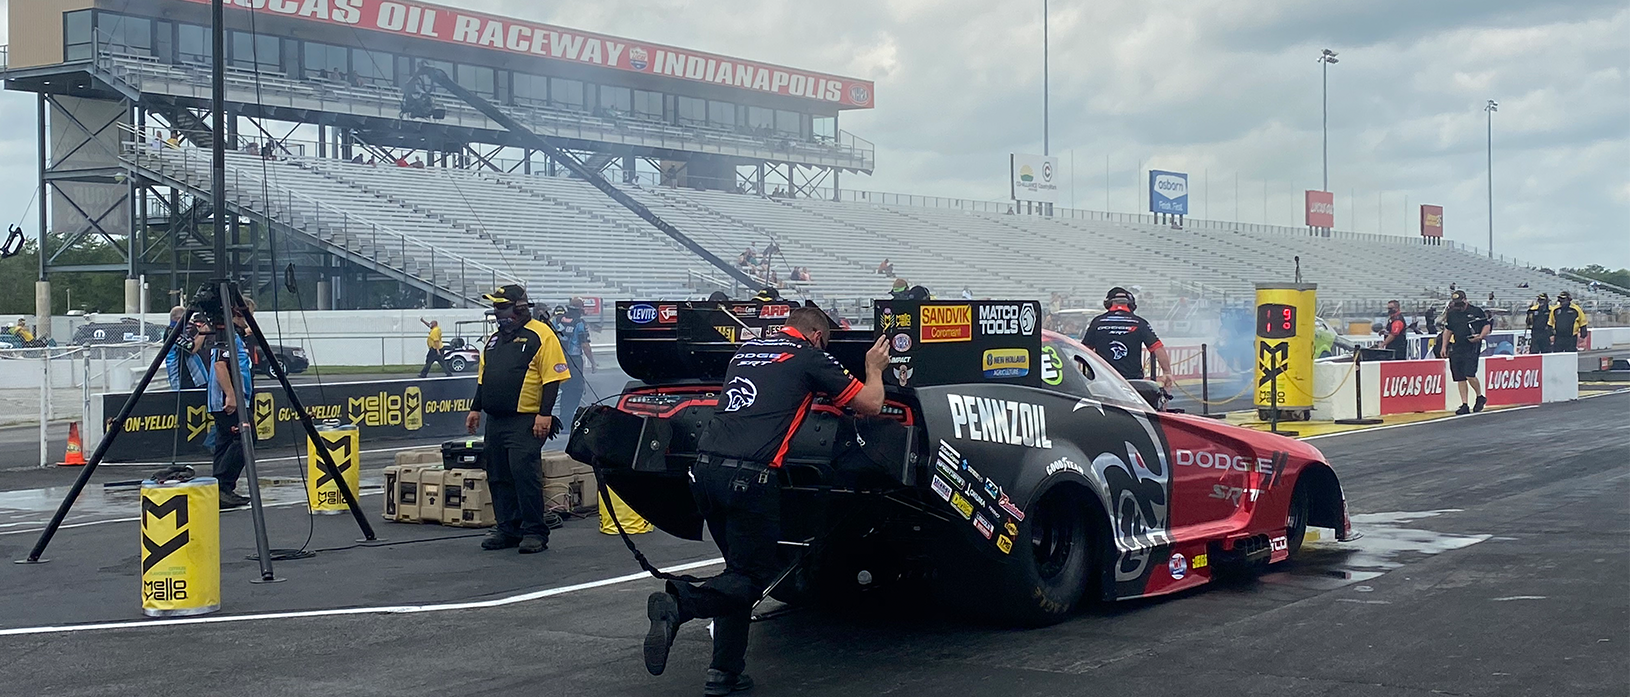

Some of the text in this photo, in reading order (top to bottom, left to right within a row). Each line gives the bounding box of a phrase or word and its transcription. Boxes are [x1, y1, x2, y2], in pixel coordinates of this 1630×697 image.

[223, 0, 362, 25] CAS
[376, 2, 439, 37] OIL
[452, 14, 626, 67] RACEWAY
[653, 50, 842, 102] INDIANAPOLIS
[760, 304, 790, 317] ARP
[922, 307, 970, 325] SANDVIK
[979, 305, 1019, 320] MATCO
[931, 326, 961, 338] Coromant
[979, 320, 1019, 335] TOOLS
[1383, 374, 1443, 398] LUCAS OIL
[1487, 369, 1539, 390] LUCAS OIL
[947, 394, 1052, 449] PENNZOIL
[1176, 449, 1273, 474] DODGE
[1208, 484, 1265, 508] SRT
